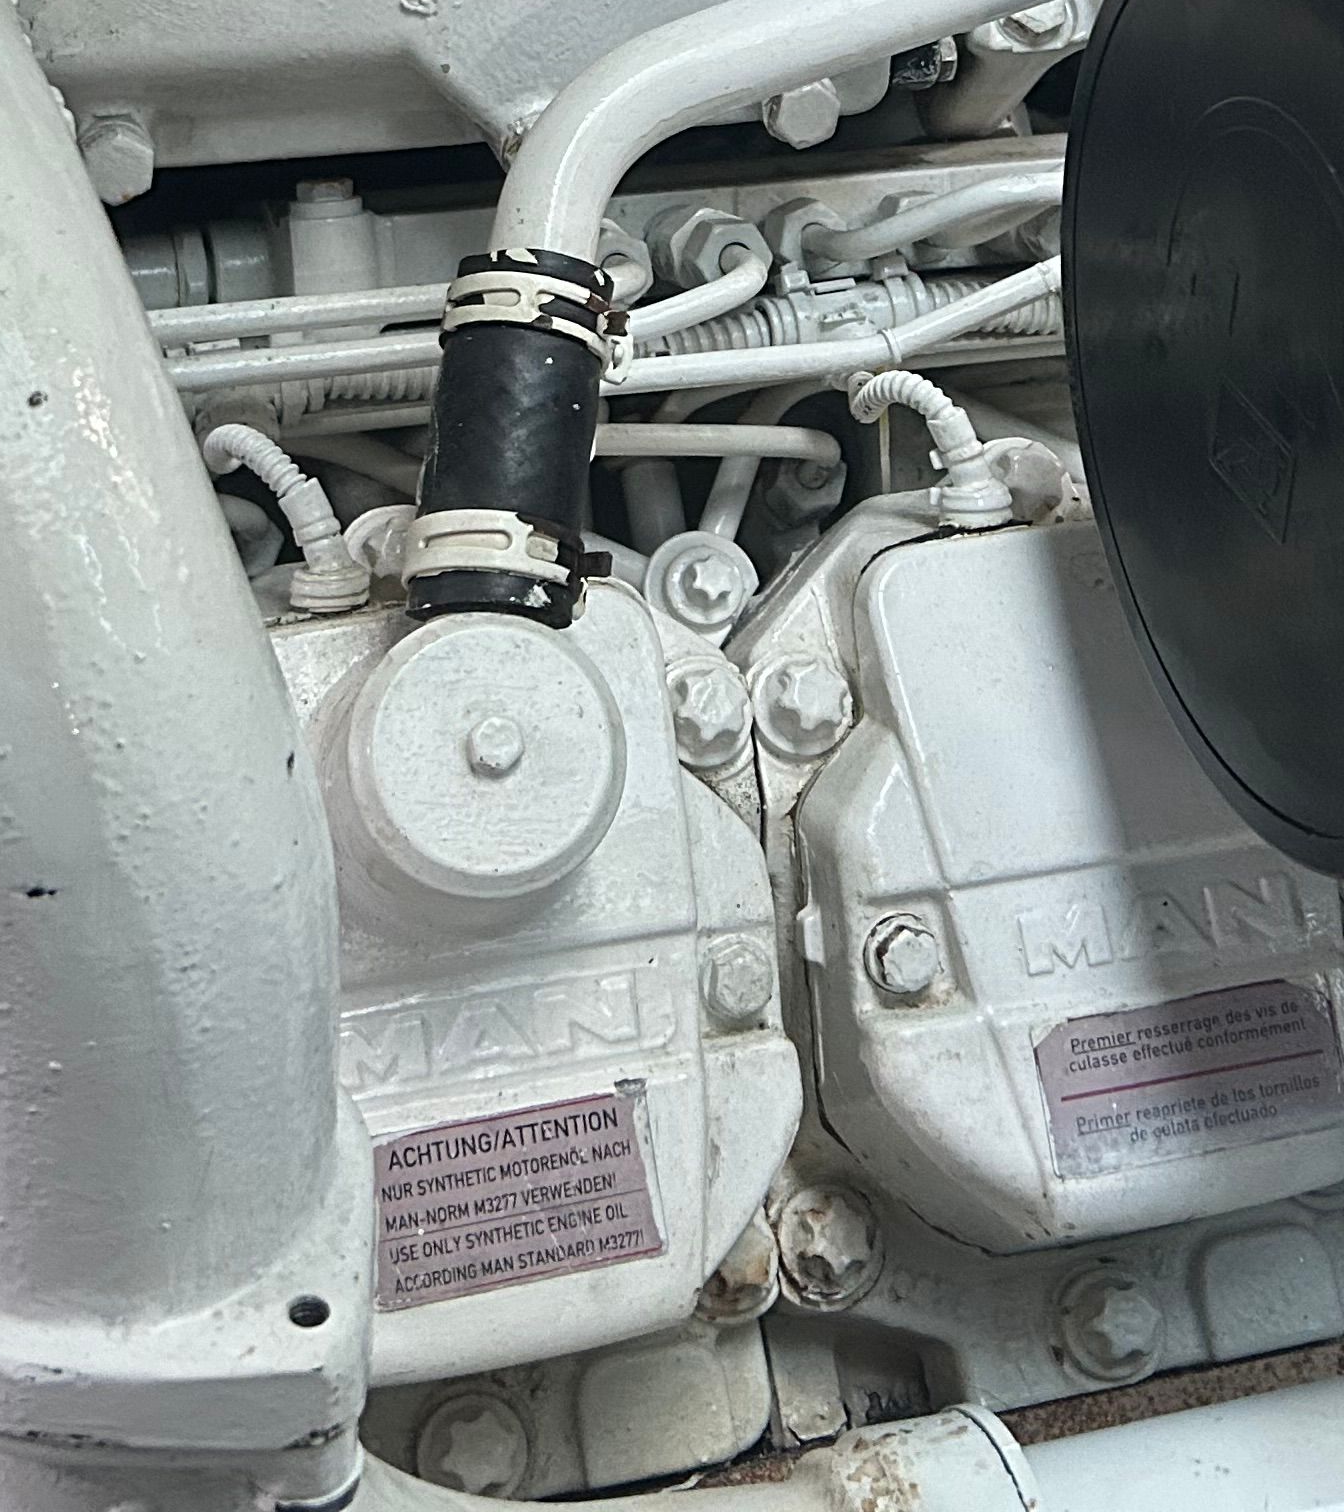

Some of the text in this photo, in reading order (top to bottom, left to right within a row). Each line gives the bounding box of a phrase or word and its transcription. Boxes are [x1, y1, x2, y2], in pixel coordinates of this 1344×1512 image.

[1016, 870, 1308, 977] MAN
[340, 969, 642, 1088] MAN
[1069, 1017, 1307, 1073] culasse effectué conformément
[1070, 999, 1299, 1054] Premier resserrage des vis de
[1076, 1074, 1321, 1136] Primer reapriete de los tornillos
[1130, 1126, 1149, 1144] de
[1205, 1103, 1278, 1130] efectuado
[388, 1107, 620, 1172] ACHTUNG/ATTENTION
[381, 1139, 632, 1204] NUR SYNTHETIC MOTORENÖL NACH
[385, 1172, 618, 1234] MAN-NORM M3277 VERWENDEN!
[389, 1202, 629, 1266] USE ONLY SYNTHETIC ENGINE OIL
[395, 1264, 477, 1294] ACCORDING
[481, 1255, 514, 1279] MAN
[518, 1238, 595, 1270] STANDARD
